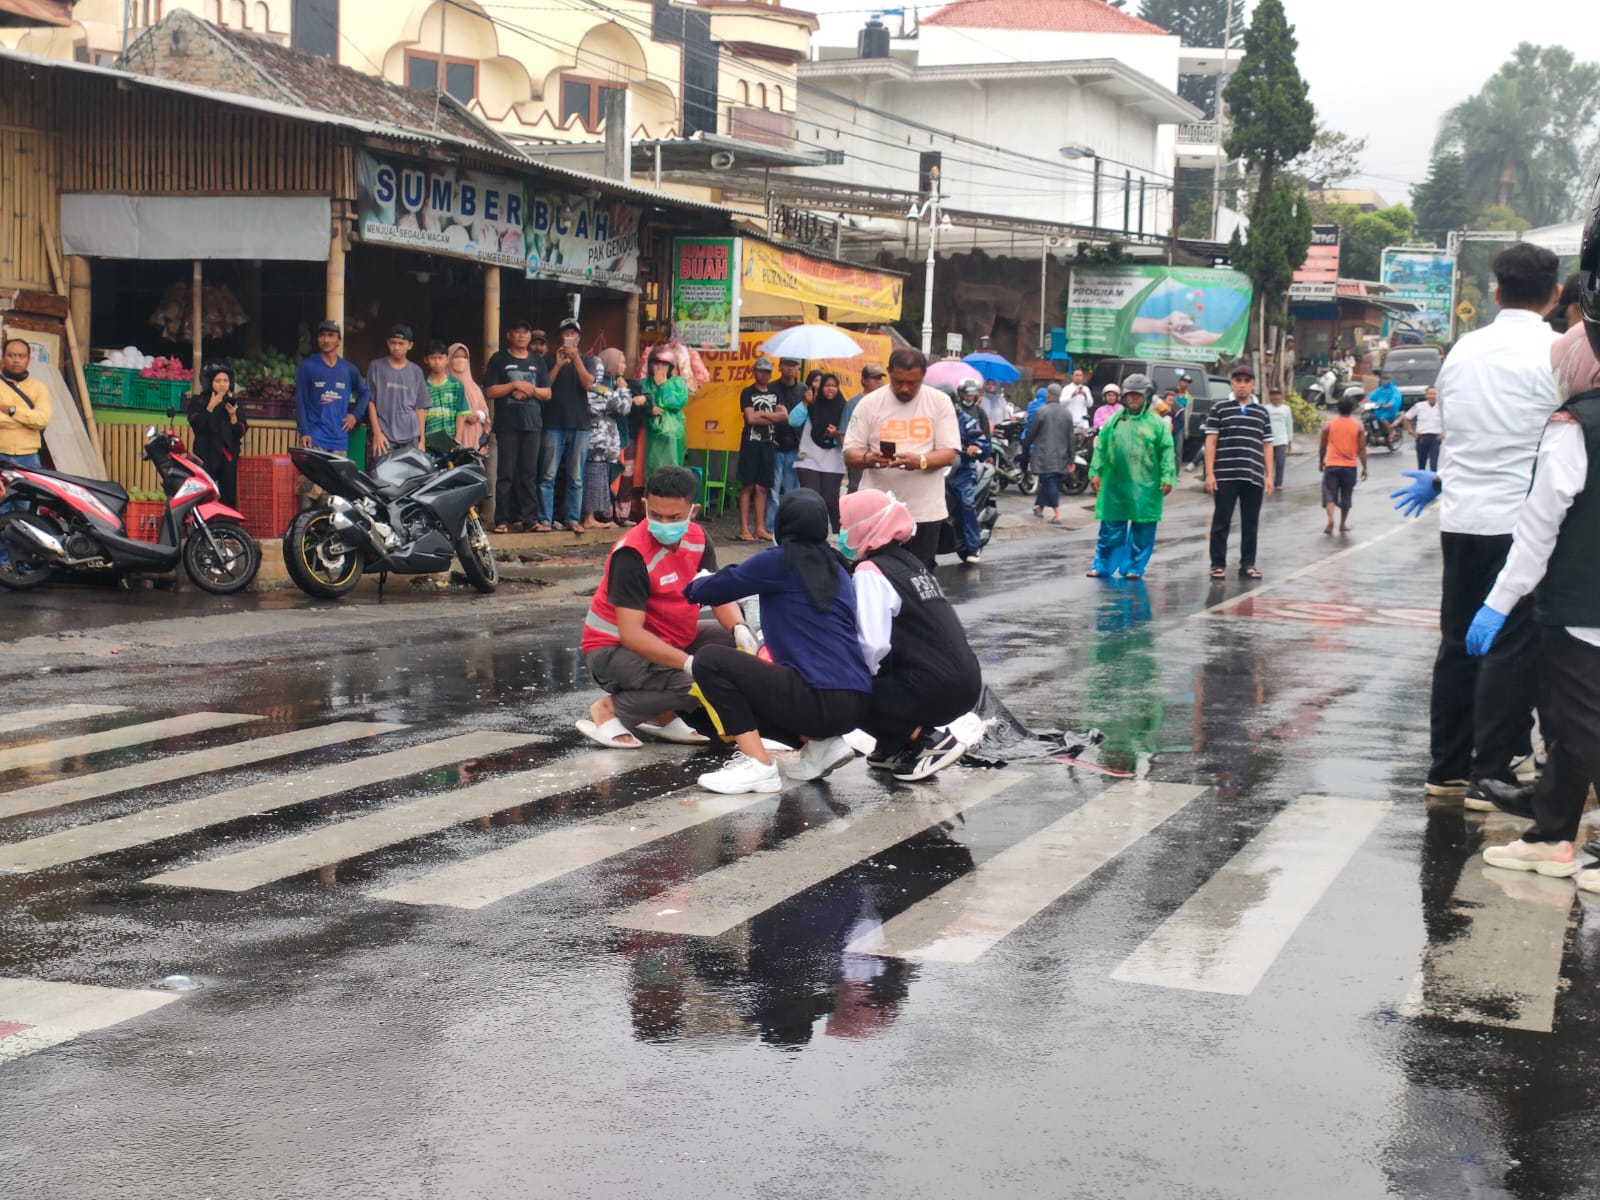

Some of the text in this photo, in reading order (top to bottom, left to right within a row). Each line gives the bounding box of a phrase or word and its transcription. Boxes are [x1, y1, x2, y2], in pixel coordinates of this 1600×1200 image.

[375, 168, 522, 226] SUMBER
[366, 223, 398, 238] MENJUAL
[399, 228, 426, 241] SEGALA
[427, 232, 450, 244] MACAM
[587, 246, 604, 265] PAK
[680, 244, 729, 259] SUMBER
[679, 258, 728, 280] BUAH
[1072, 287, 1125, 297] PROGRAM
